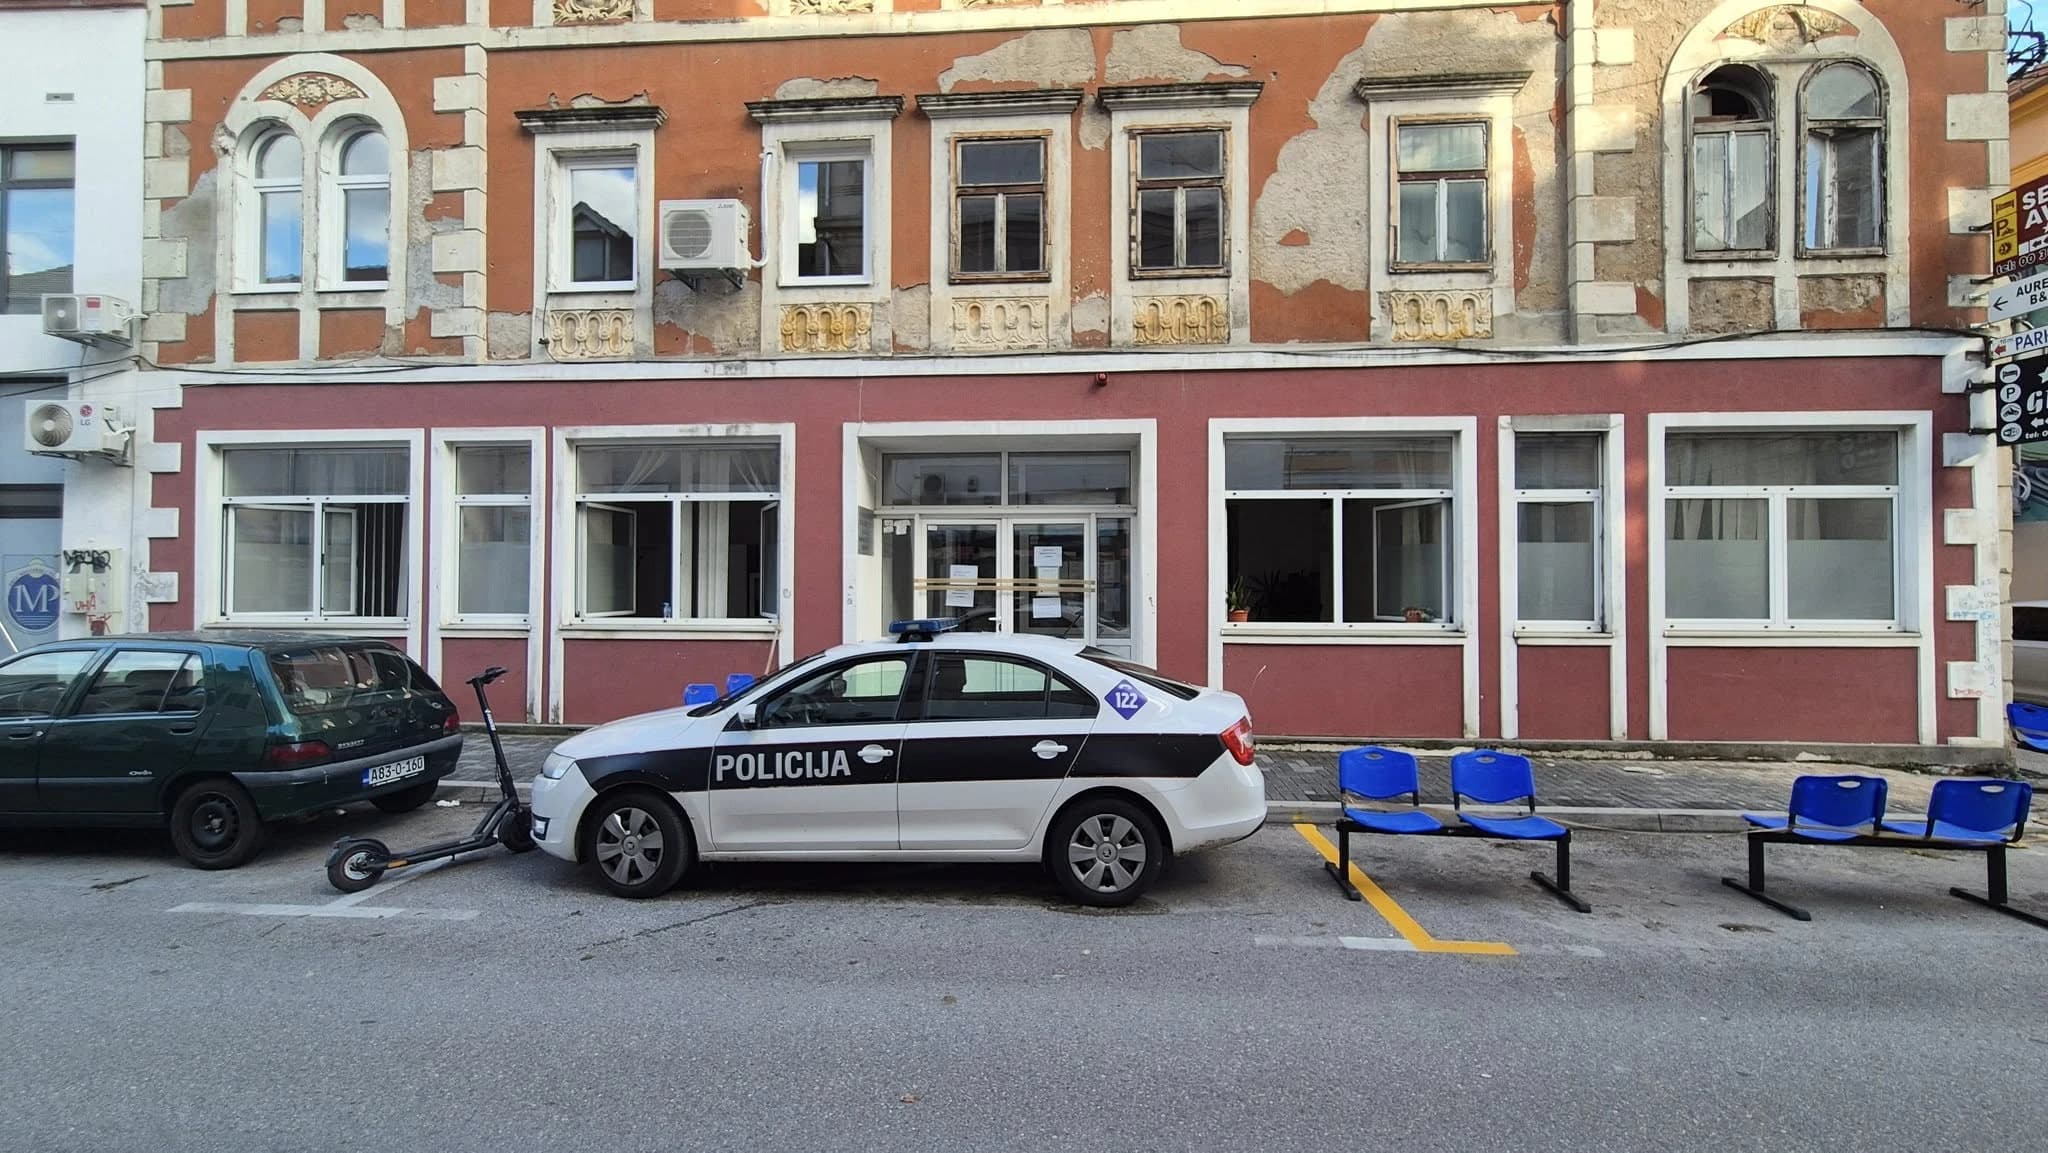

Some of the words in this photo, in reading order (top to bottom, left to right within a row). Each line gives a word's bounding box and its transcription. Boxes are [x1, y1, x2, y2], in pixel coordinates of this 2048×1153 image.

[2018, 253, 2036, 267] 00
[1115, 692, 1138, 709] 122
[716, 750, 852, 782] POLICIJA
